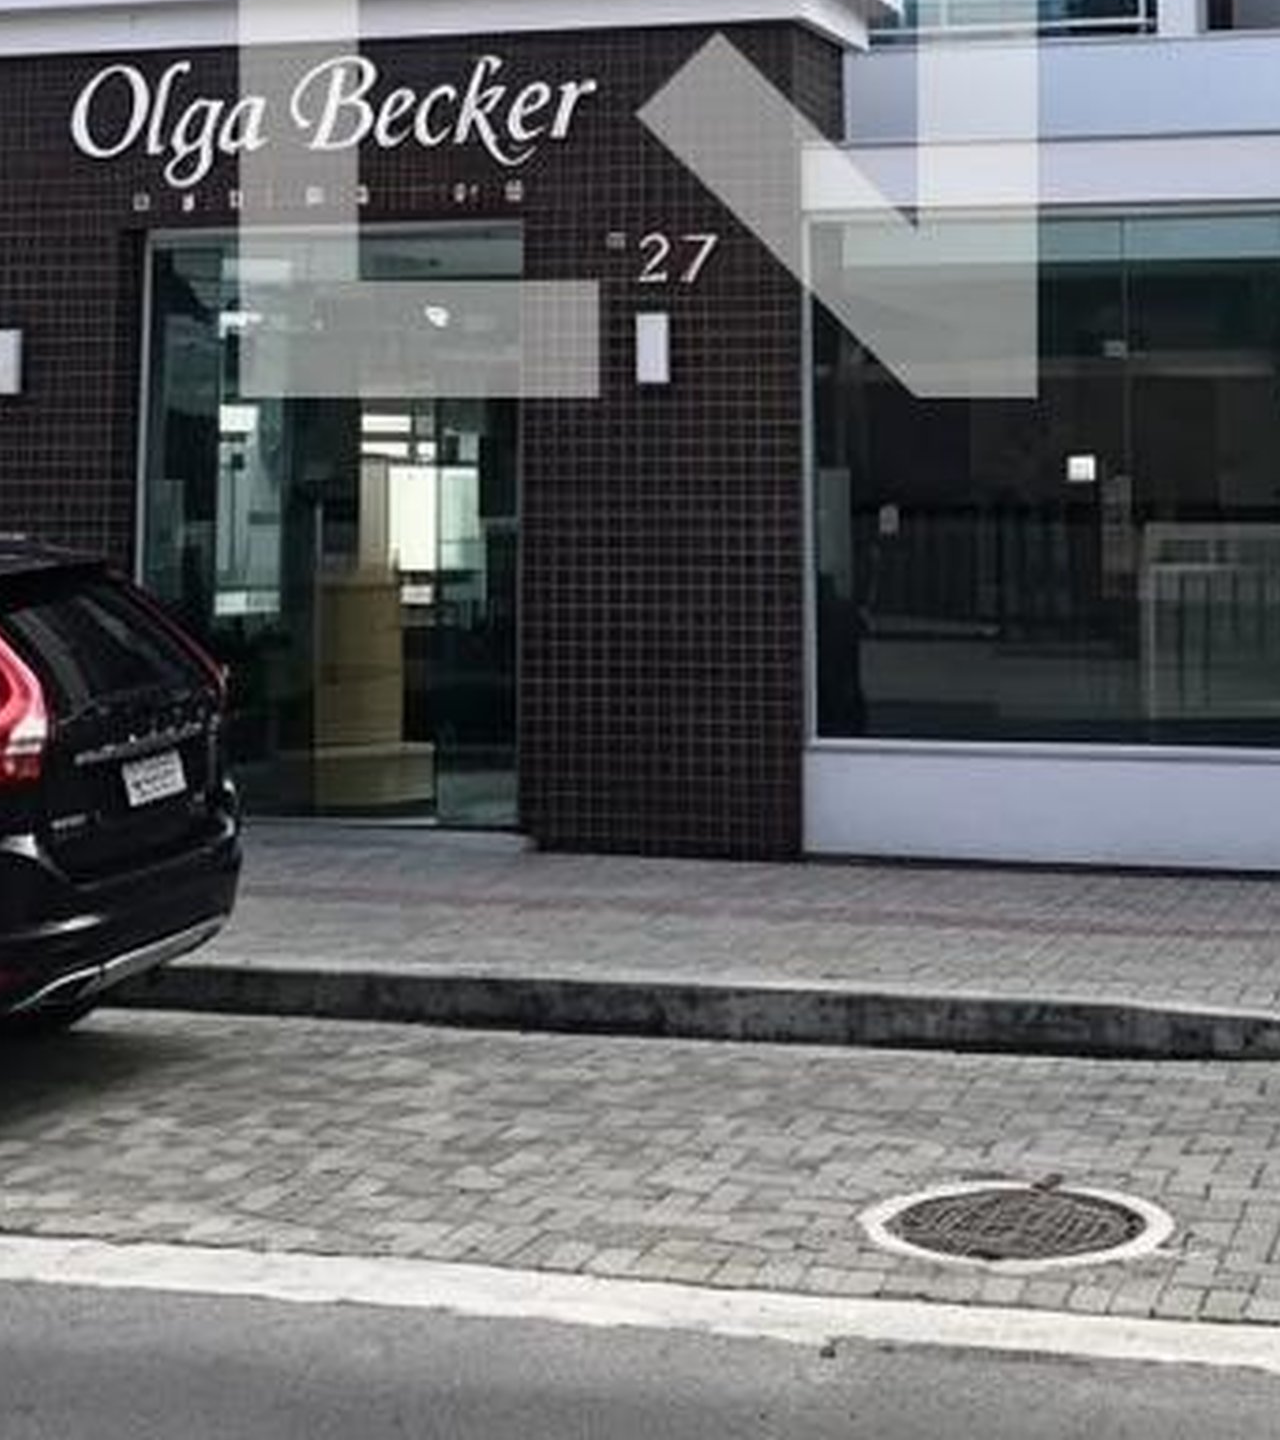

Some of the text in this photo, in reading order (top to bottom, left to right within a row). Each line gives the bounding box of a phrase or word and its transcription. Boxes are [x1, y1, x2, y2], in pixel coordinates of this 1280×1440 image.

[70, 55, 597, 188] Olga Becker
[638, 232, 718, 283] 27
